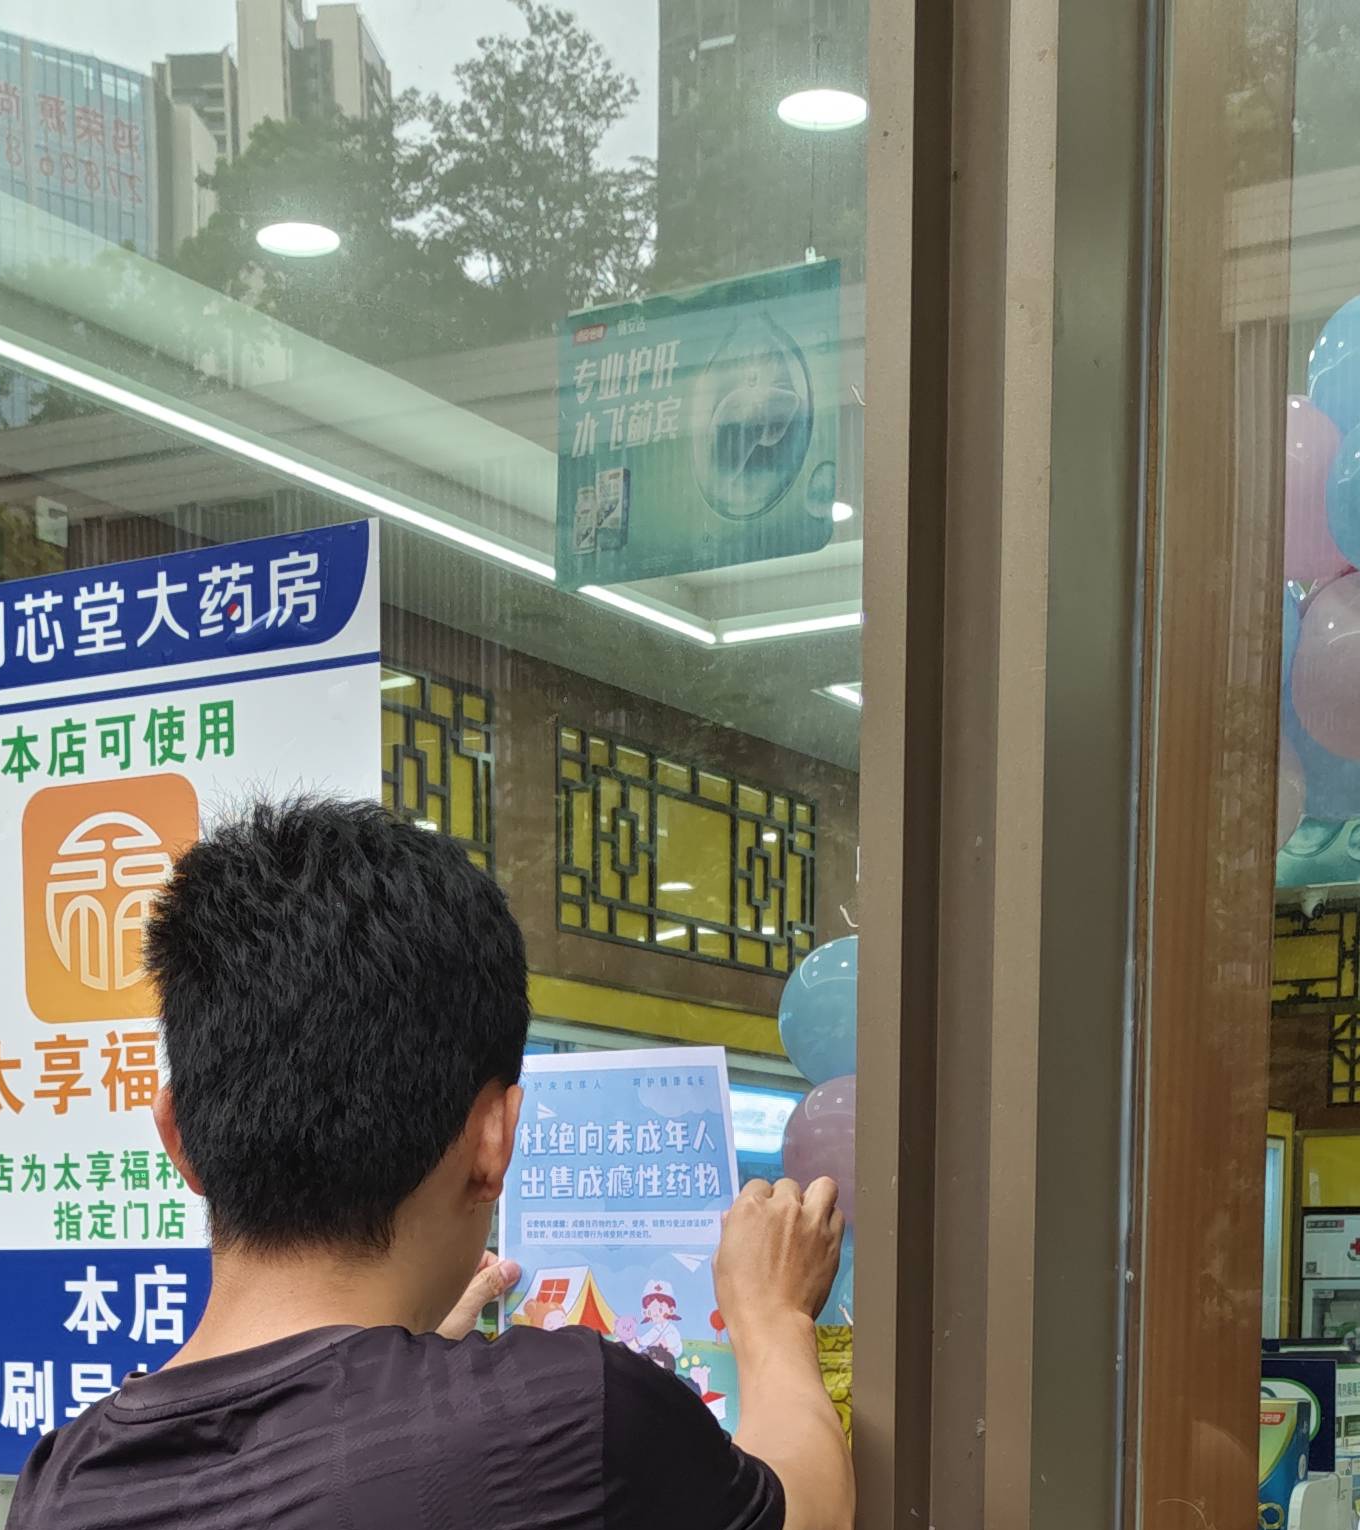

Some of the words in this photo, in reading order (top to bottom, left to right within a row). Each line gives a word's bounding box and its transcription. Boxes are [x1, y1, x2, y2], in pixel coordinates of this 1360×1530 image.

[573, 339, 681, 404] 专业护肝
[1, 699, 236, 784] 本店可使用
[520, 1119, 717, 1157] 杜绝向未成年人
[520, 1161, 722, 1201] 出售成瘾性药物
[53, 1199, 187, 1242] 指定门店
[63, 1265, 188, 1345] 本店
